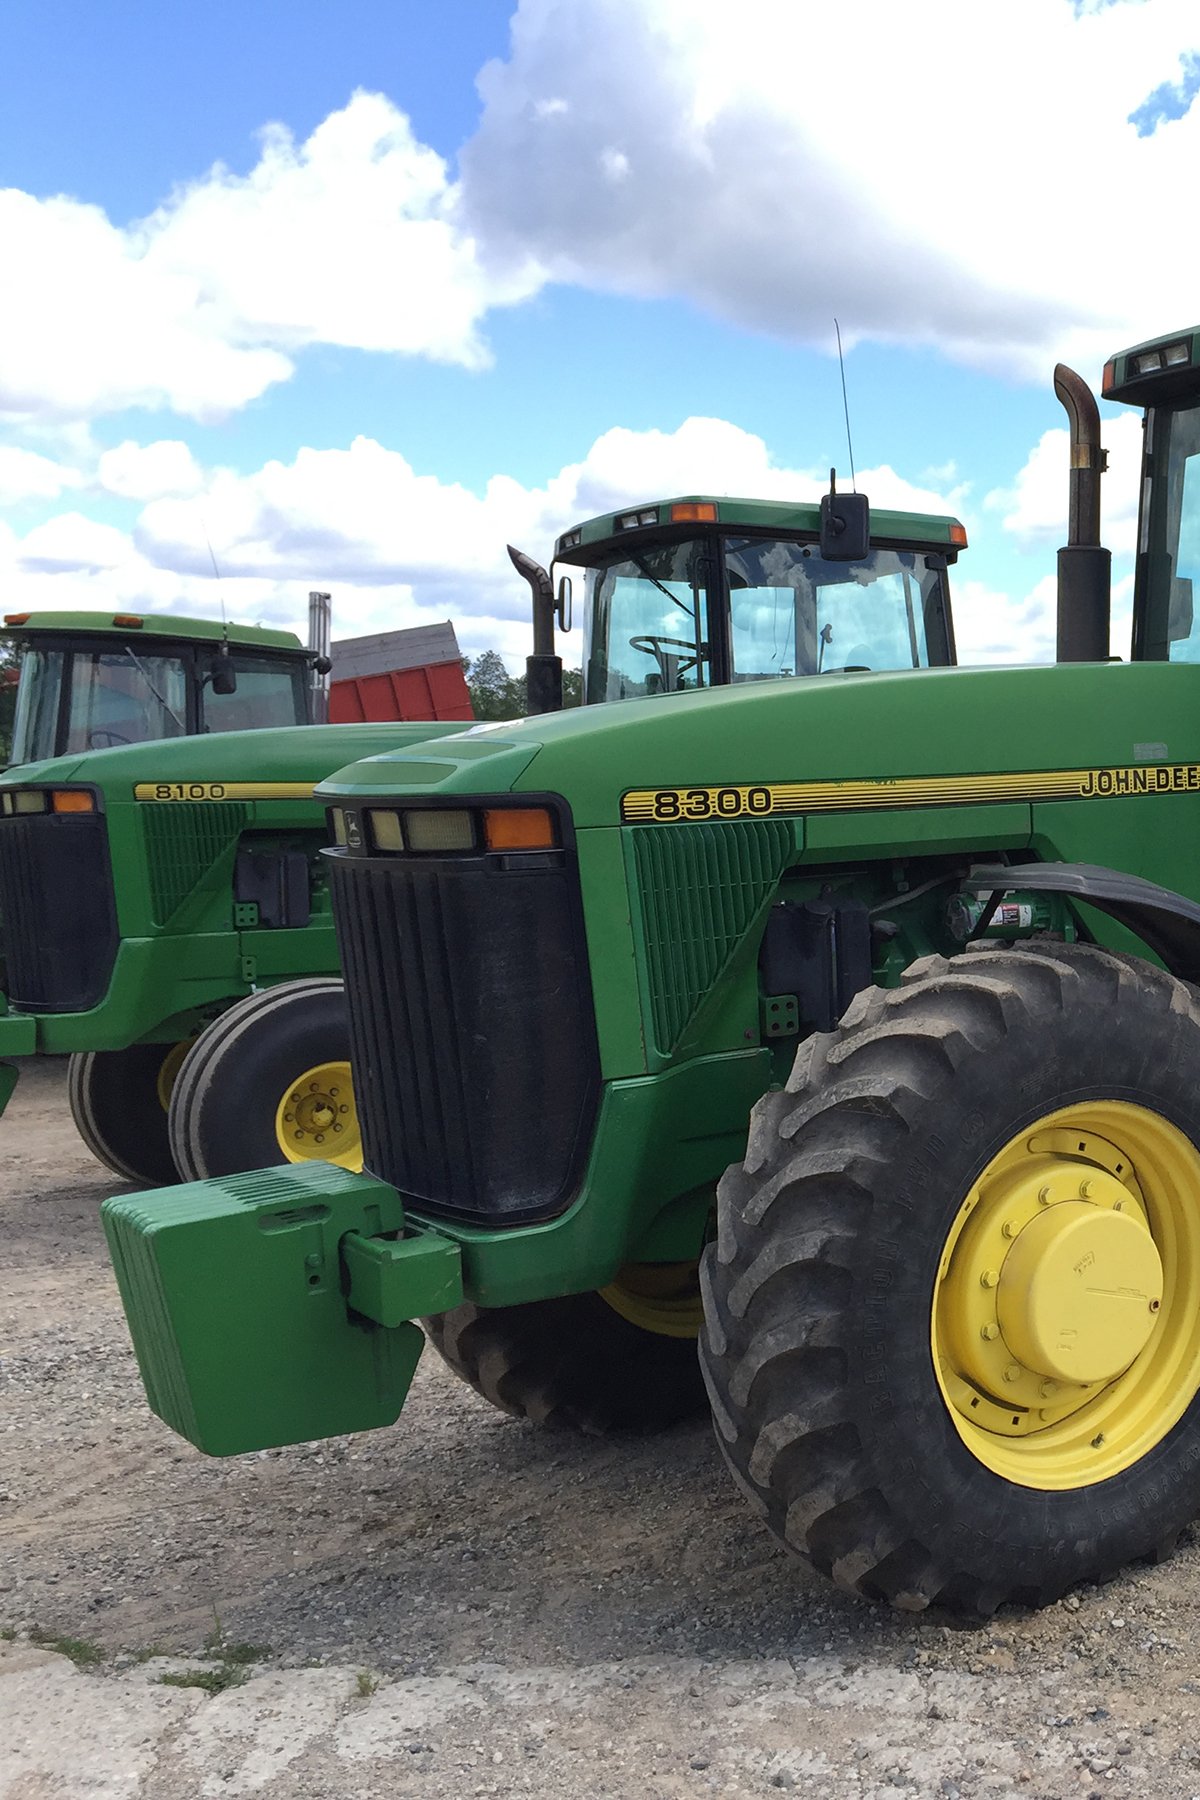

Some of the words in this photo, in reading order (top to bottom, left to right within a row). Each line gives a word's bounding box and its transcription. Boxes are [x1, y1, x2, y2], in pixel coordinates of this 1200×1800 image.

[155, 784, 226, 800] 8100
[1081, 769, 1147, 796] JOHN
[653, 787, 772, 820] 8300
[860, 1238, 910, 1442] RACTION
